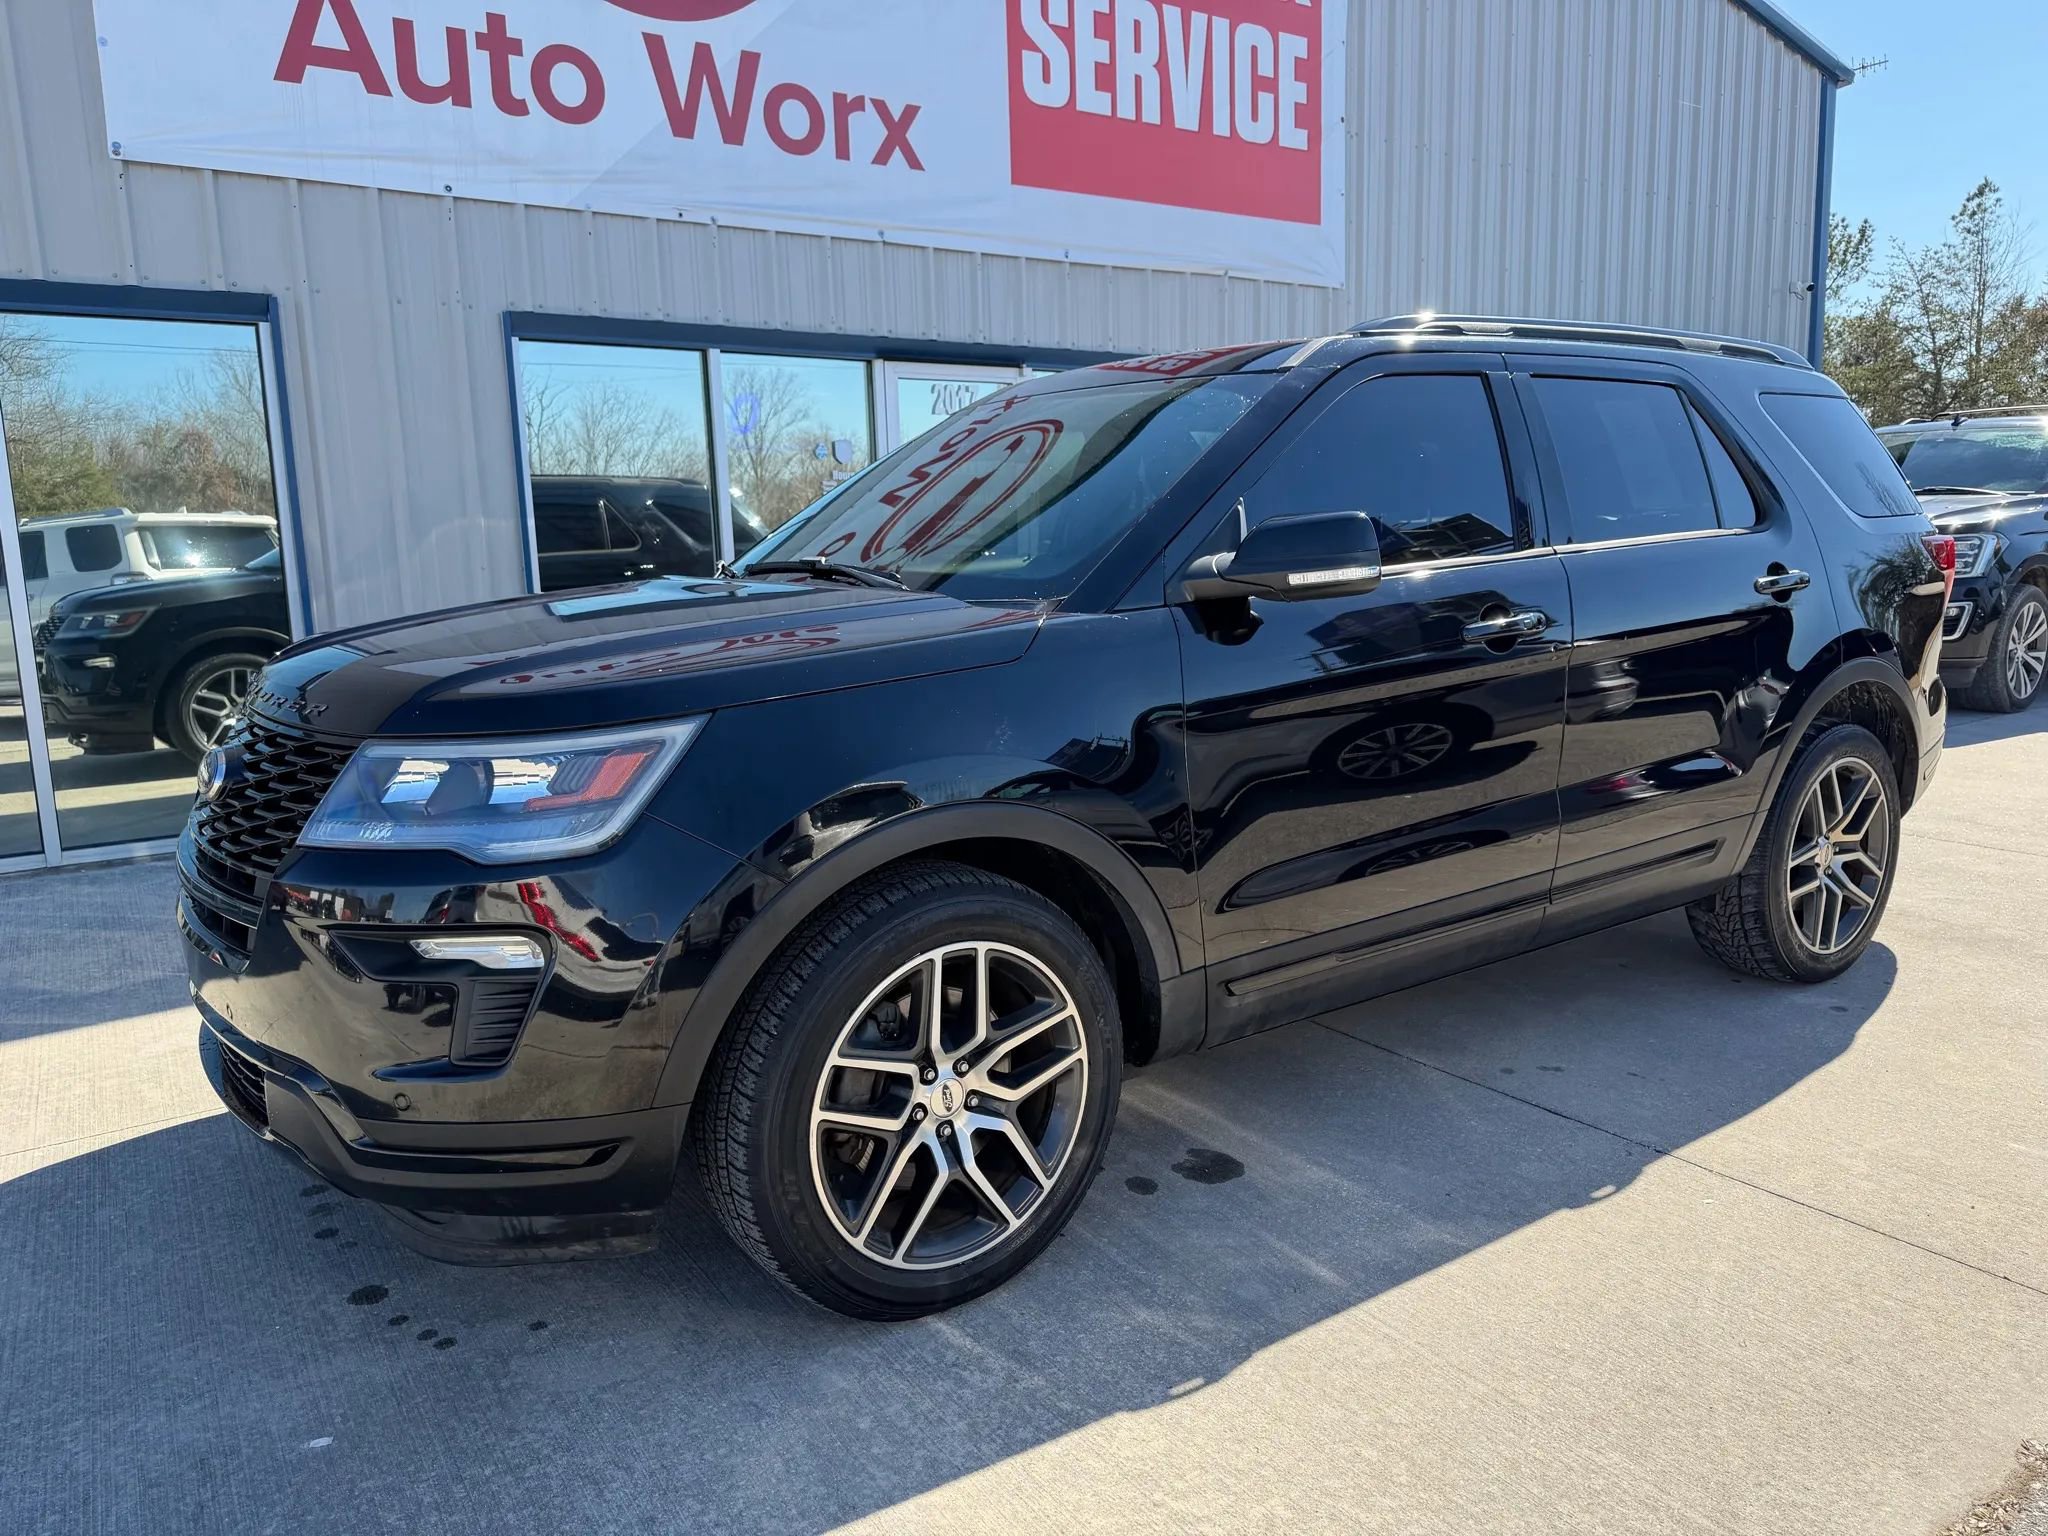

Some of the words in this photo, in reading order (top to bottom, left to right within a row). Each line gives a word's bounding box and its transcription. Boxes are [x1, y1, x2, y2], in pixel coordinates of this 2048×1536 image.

[273, 0, 606, 126] Auto
[641, 31, 926, 172] Worx
[1020, 0, 1309, 151] SERVICE
